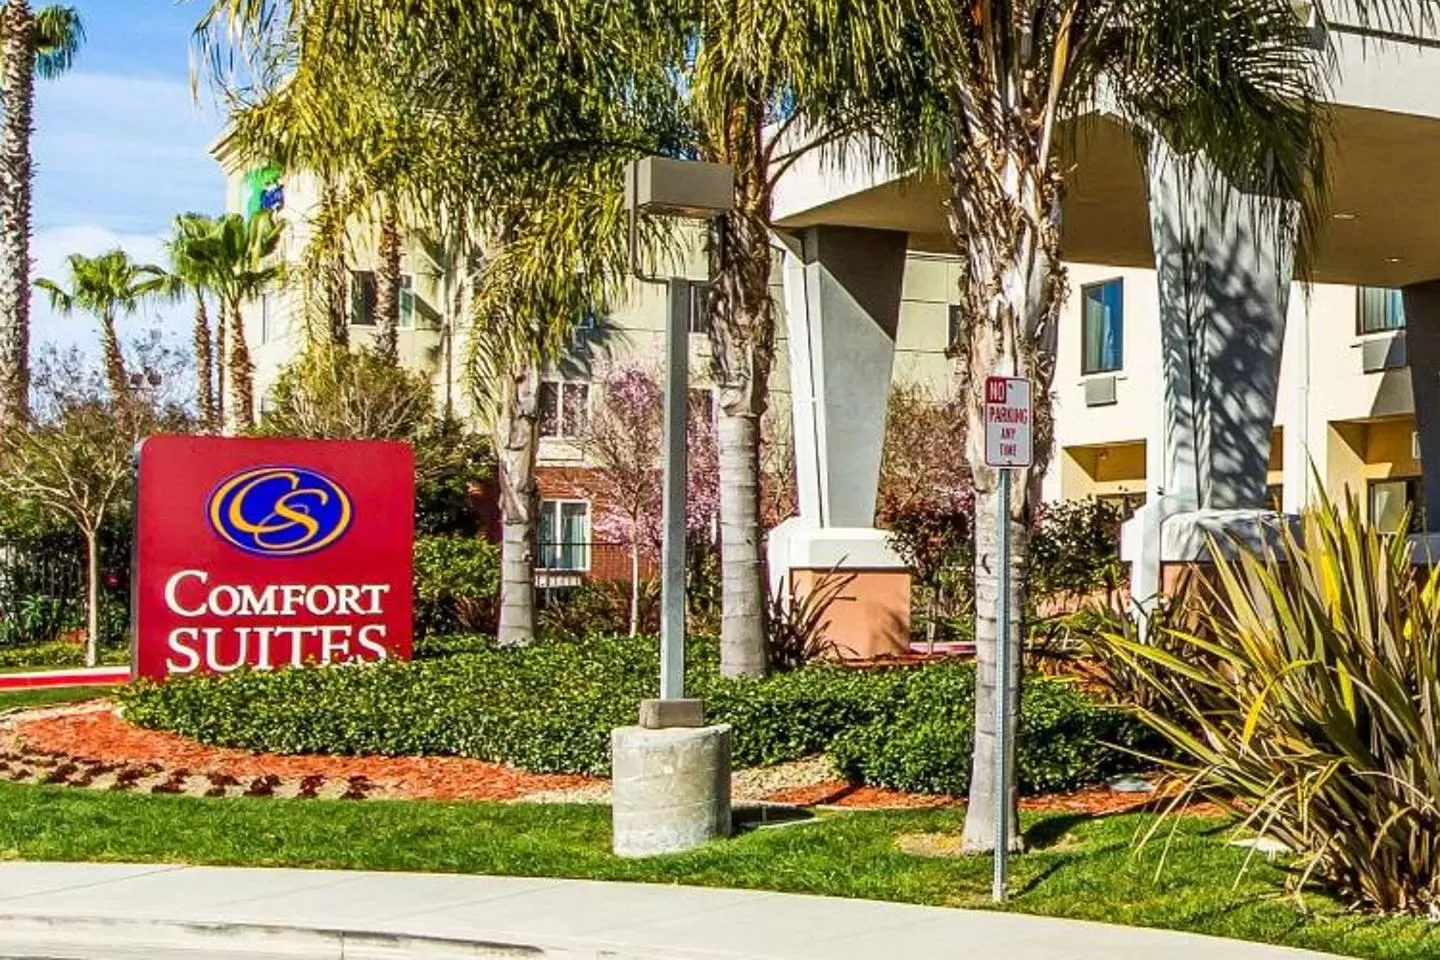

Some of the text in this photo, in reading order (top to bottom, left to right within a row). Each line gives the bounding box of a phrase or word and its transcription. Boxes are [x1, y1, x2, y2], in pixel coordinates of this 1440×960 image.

[989, 381, 1005, 401] NO
[989, 406, 1027, 424] PARKING
[1001, 427, 1016, 440] ANY
[1000, 443, 1017, 457] TIME
[164, 569, 390, 617] COMFORT
[166, 624, 387, 673] SUITES
